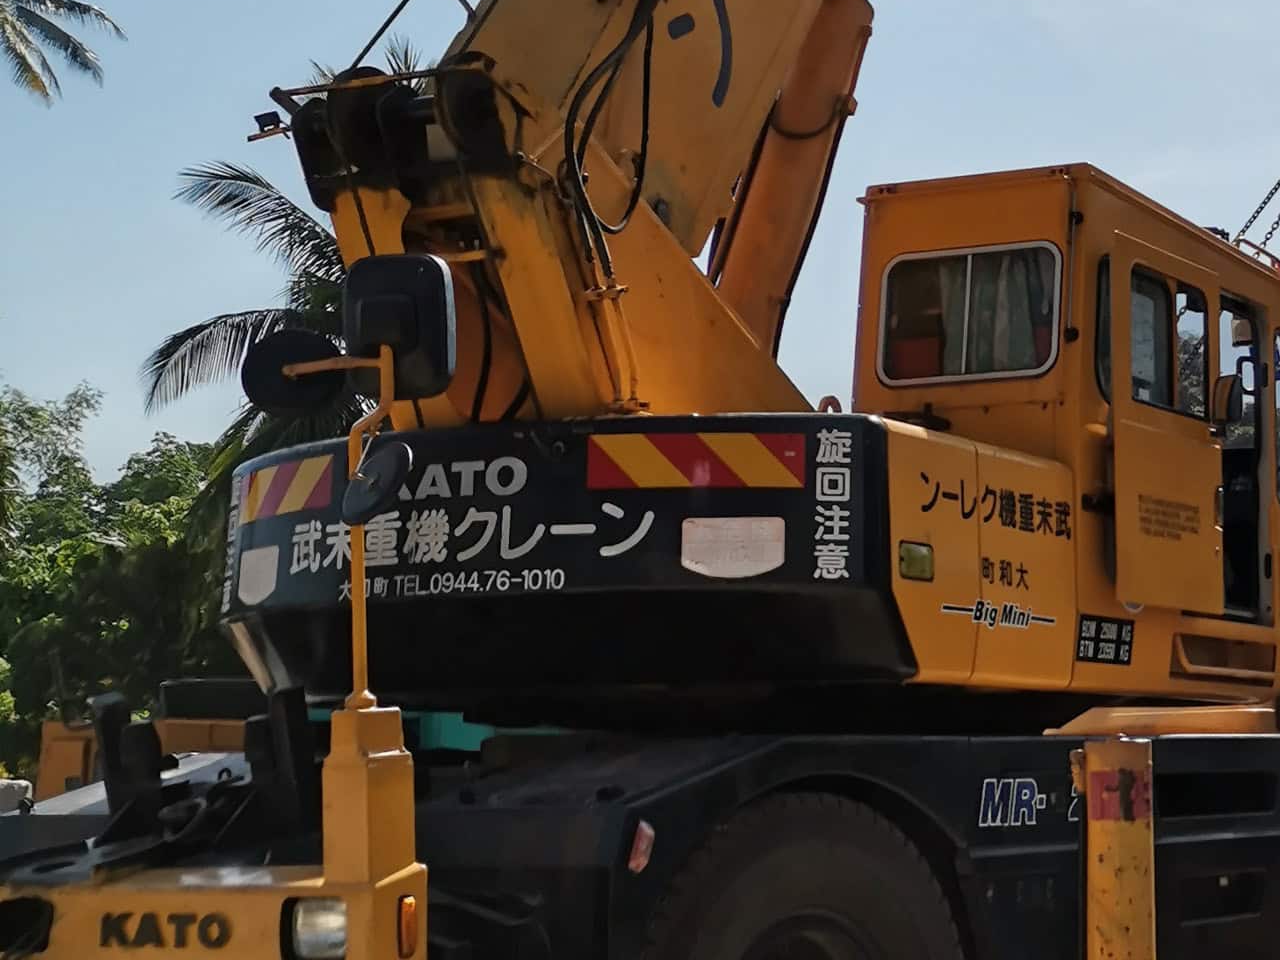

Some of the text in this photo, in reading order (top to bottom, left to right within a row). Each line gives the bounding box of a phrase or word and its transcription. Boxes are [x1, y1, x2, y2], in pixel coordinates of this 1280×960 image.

[813, 428, 852, 579] 旋回注意
[289, 501, 656, 575] 武末重機クレーン
[973, 599, 1032, 627] Big Mini
[99, 912, 232, 949] KATO
